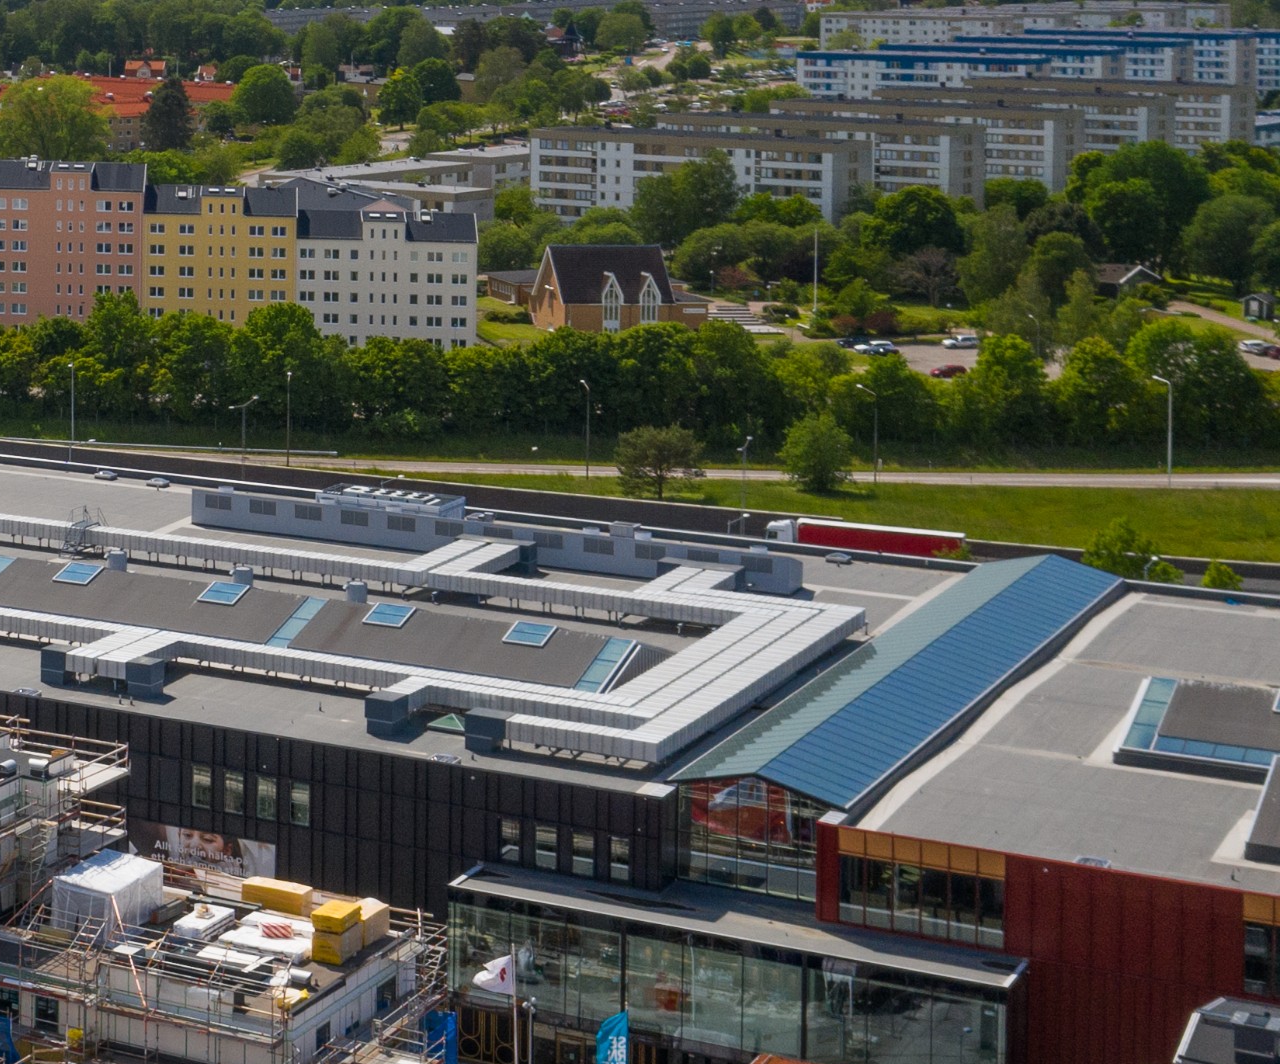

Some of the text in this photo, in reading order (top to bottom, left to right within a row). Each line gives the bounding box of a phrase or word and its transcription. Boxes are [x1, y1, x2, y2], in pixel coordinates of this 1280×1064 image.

[154, 839, 172, 851] Allt
[190, 847, 206, 858] din
[151, 852, 166, 861] ett
